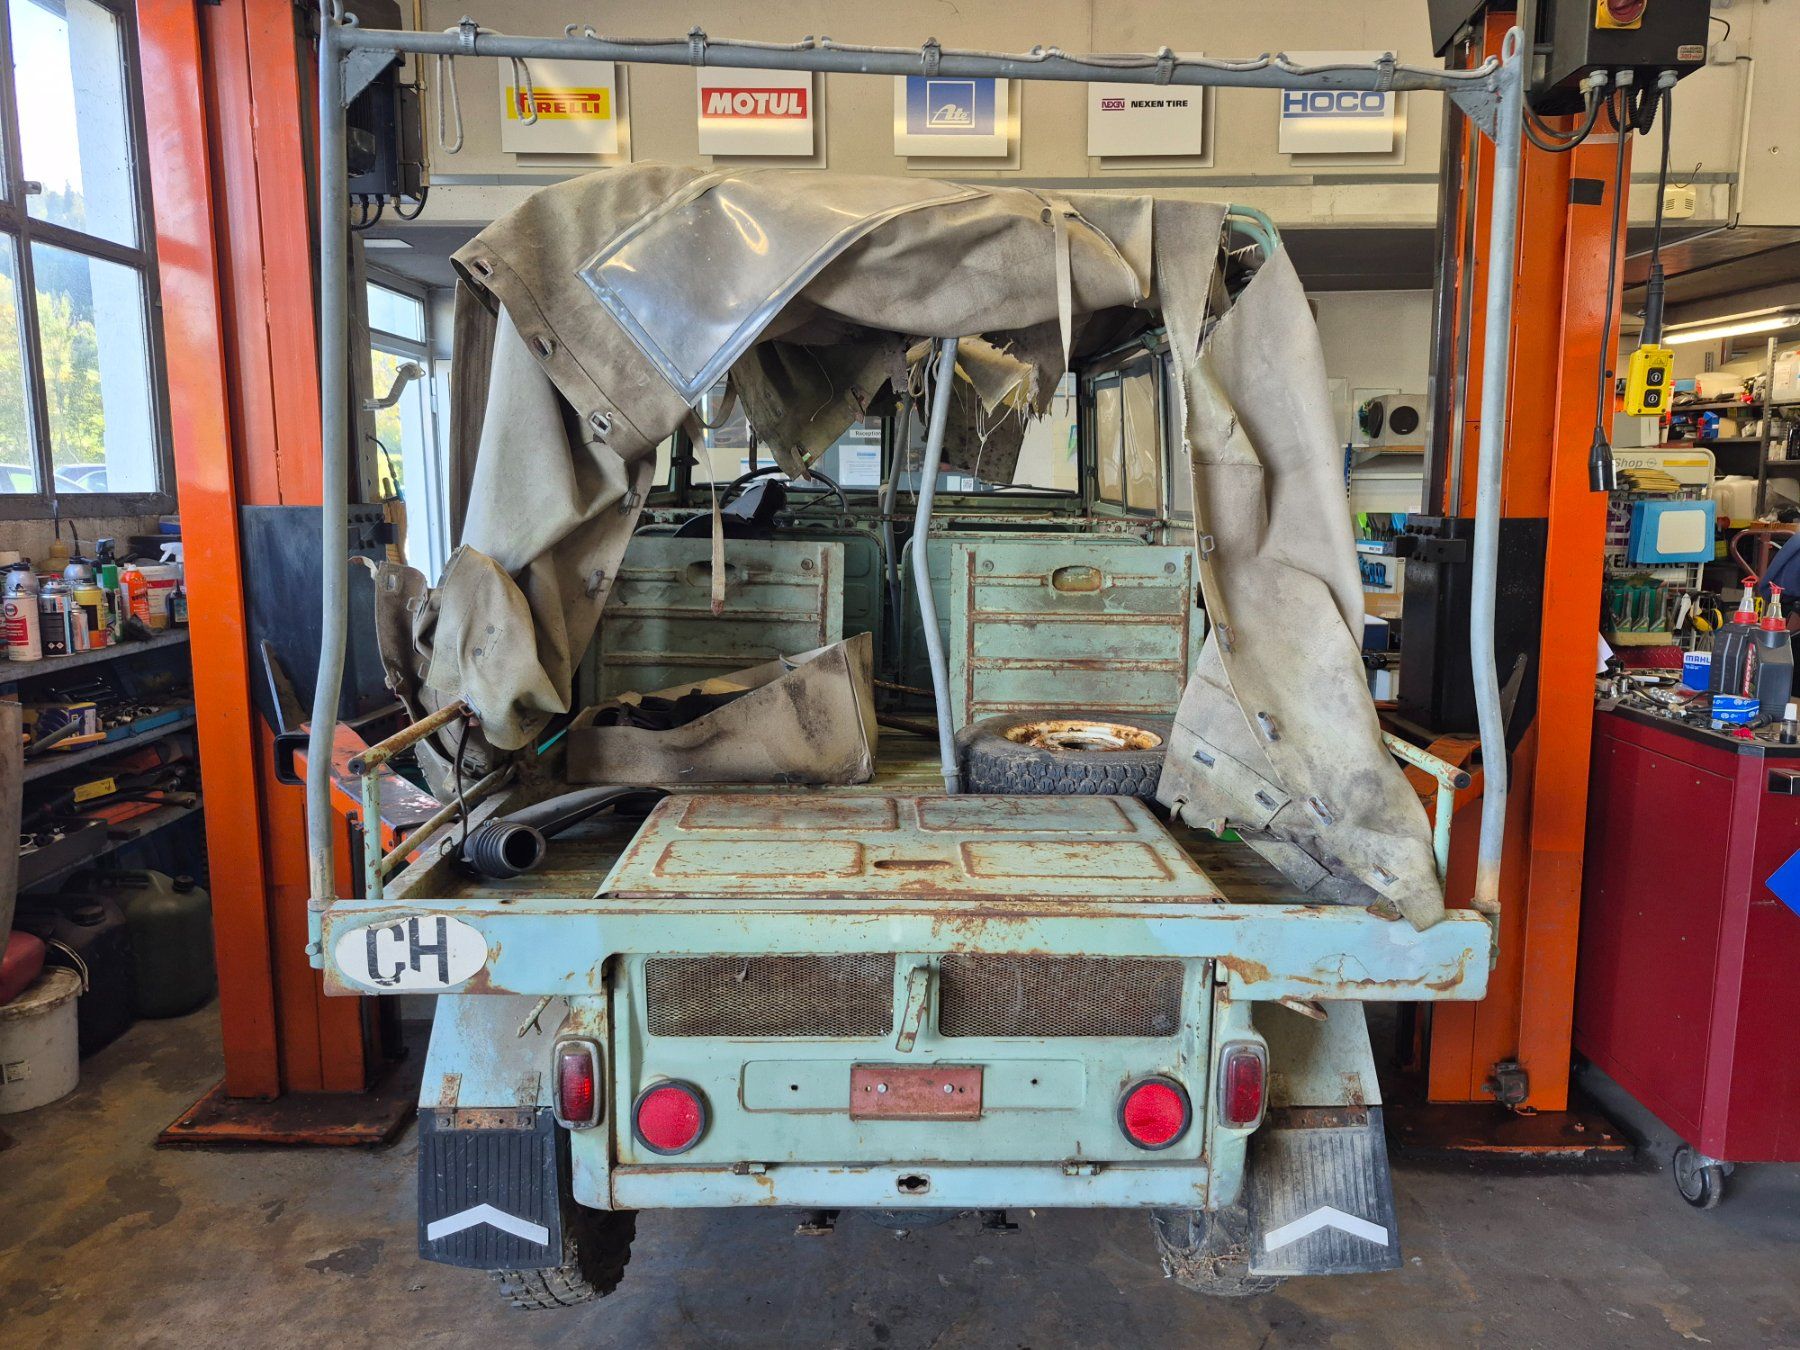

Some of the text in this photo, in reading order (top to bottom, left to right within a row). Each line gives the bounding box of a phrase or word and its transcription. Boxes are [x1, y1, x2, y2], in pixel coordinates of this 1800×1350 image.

[707, 92, 802, 115] MOTUL
[1283, 92, 1385, 112] HOCO
[1685, 655, 1711, 663] MAHL
[366, 916, 449, 985] CH
